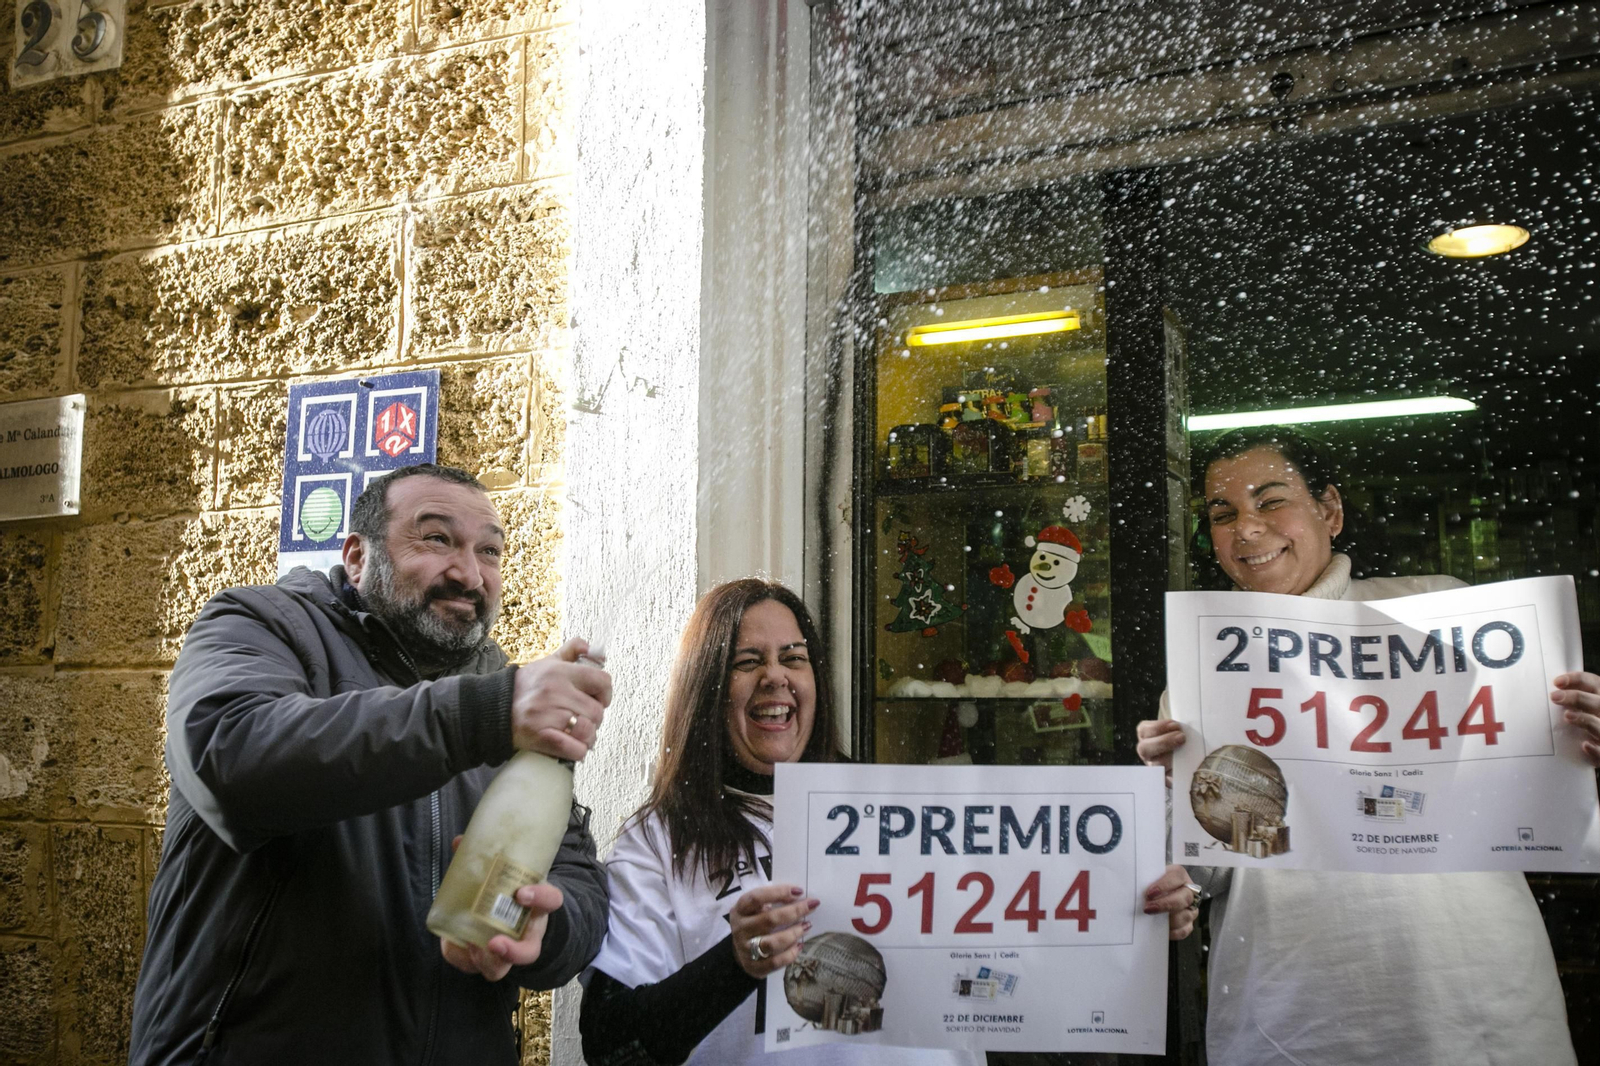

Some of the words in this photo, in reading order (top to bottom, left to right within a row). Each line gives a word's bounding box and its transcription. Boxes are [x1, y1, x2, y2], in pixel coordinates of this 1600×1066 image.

[15, 0, 108, 67] 25
[24, 425, 77, 441] Caland
[1245, 685, 1506, 753] 51244
[1351, 833, 1364, 842] 22
[1367, 834, 1381, 843] DE
[1383, 833, 1440, 844] DICIEMBRE
[1356, 845, 1387, 854] SORTEO
[1389, 847, 1400, 855] DE
[1401, 846, 1438, 855] NAVIDAD
[851, 870, 1097, 934] 51244
[943, 1014, 954, 1023] 22
[957, 1014, 970, 1023] DE
[973, 1014, 1024, 1024] DICIEMBRE
[946, 1025, 975, 1033] SORTEO
[987, 1026, 1021, 1034] NAVIDAD
